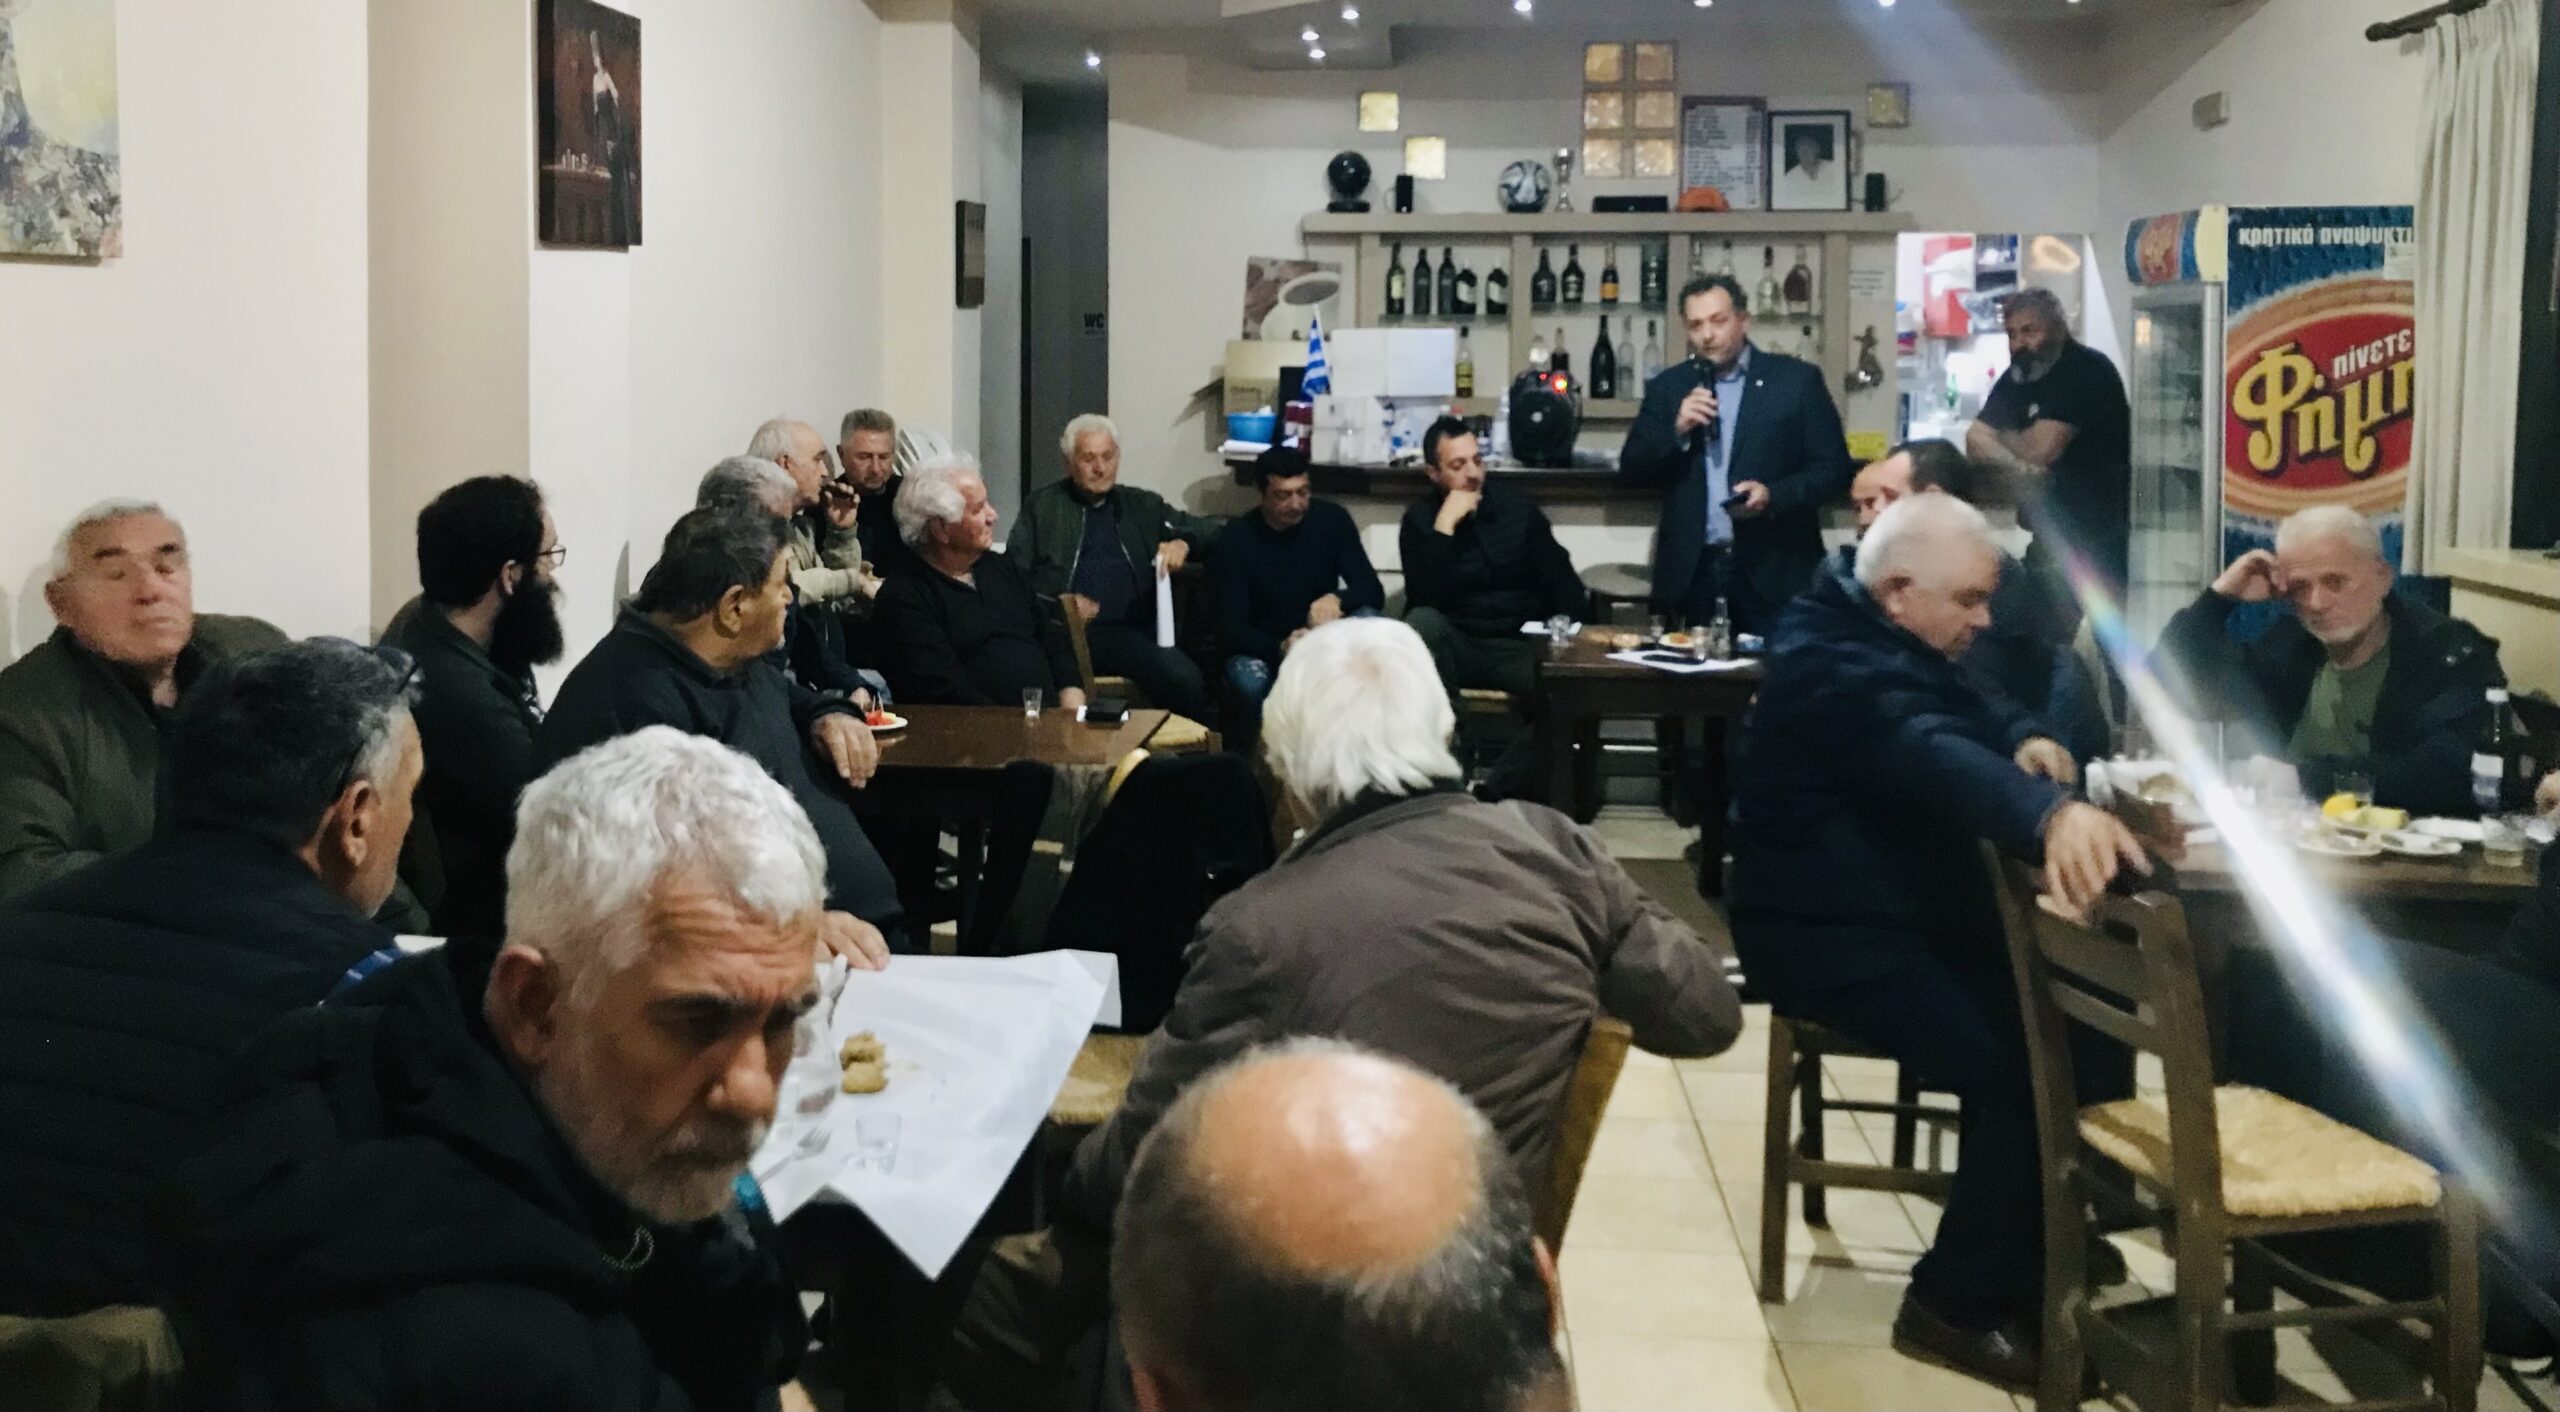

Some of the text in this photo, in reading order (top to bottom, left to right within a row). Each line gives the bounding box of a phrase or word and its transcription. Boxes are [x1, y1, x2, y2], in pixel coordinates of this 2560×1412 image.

[2239, 223, 2314, 248] κρητικά
[1084, 312, 1105, 329] WC
[2333, 328, 2412, 379] πίνετε
